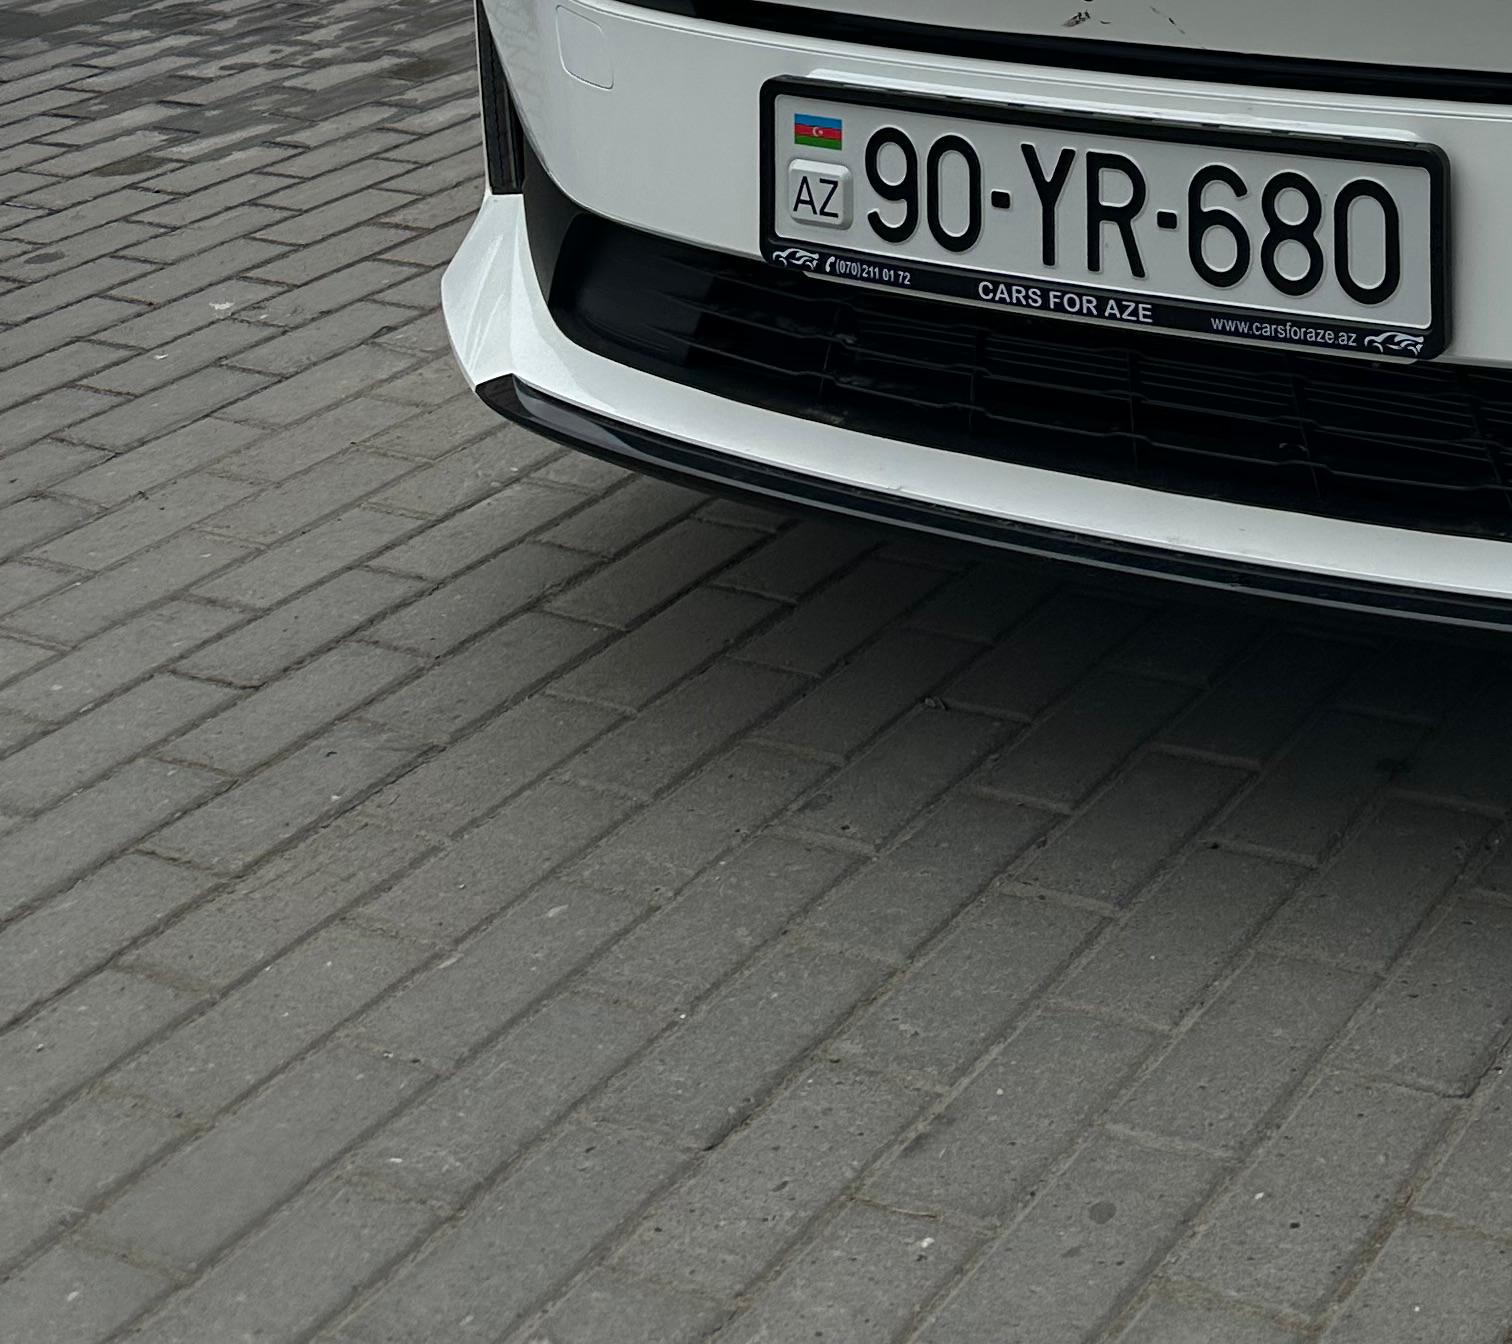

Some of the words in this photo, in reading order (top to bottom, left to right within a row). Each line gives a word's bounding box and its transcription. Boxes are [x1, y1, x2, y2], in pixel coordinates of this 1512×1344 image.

[793, 175, 839, 219] AZ
[864, 126, 1401, 306] 90-YR-680
[882, 268, 895, 282] 01
[898, 270, 911, 285] 72
[978, 281, 1042, 307] CARS
[1048, 291, 1098, 315] FOR
[1104, 299, 1153, 323] AZE
[1210, 317, 1358, 346] www.carsforaze.az
